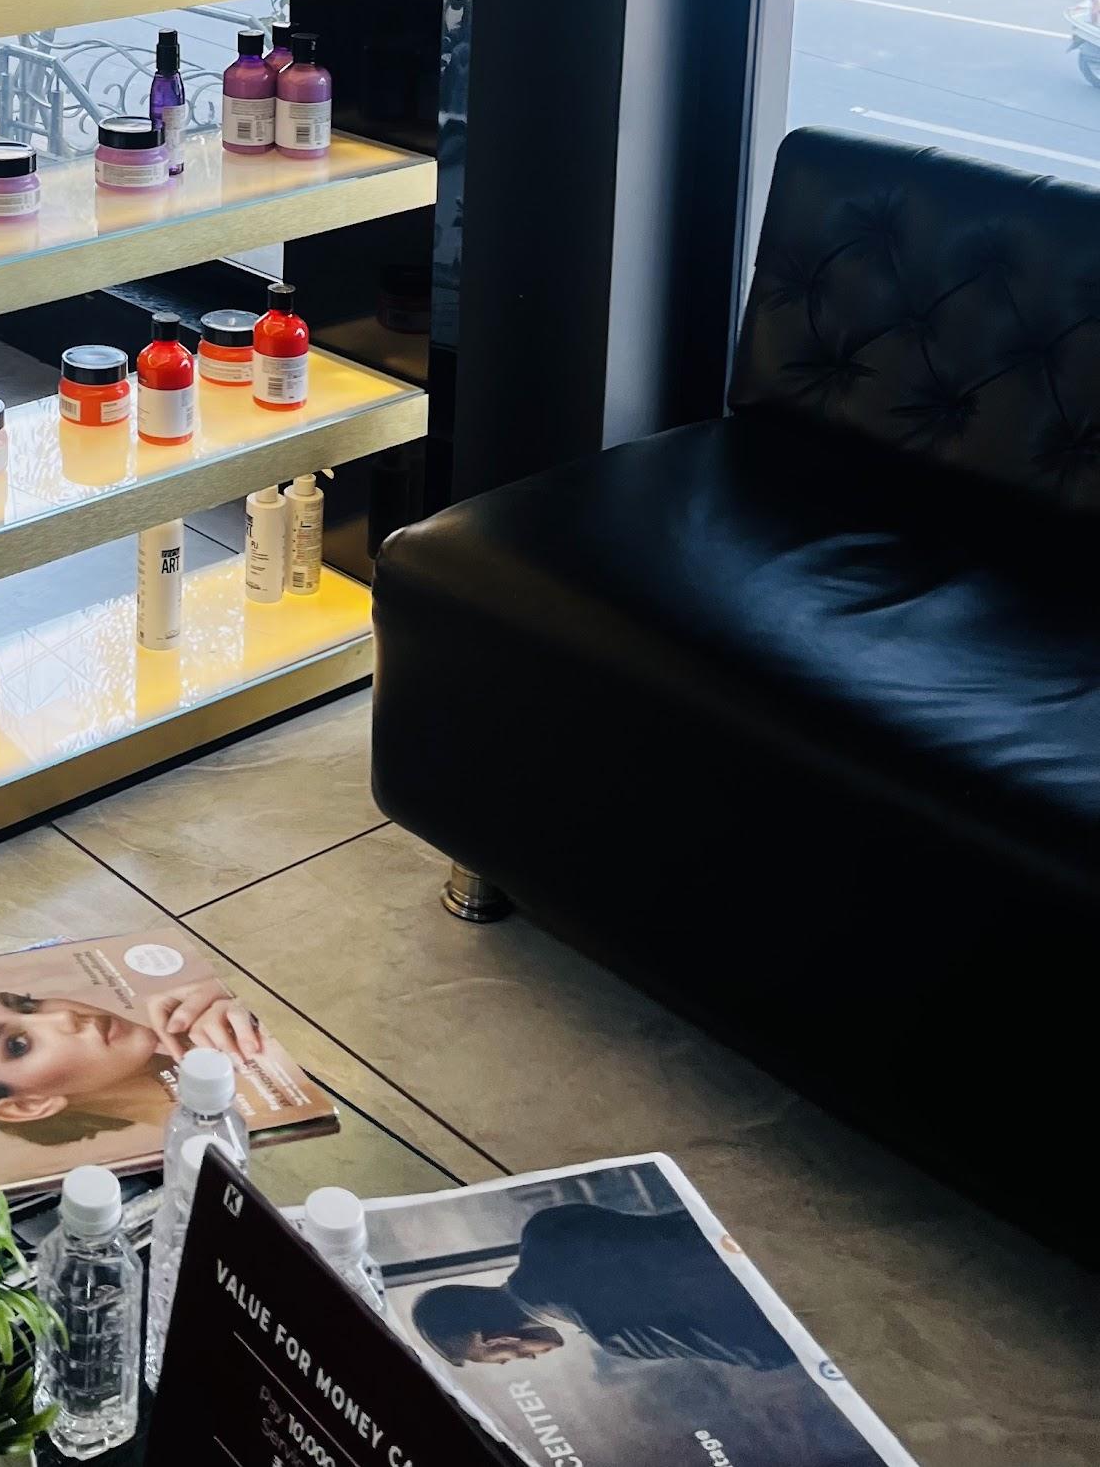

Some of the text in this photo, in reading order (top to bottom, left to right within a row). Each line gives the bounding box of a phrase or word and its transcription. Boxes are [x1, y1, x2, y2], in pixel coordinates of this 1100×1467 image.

[161, 555, 180, 574] ART
[216, 1259, 272, 1332] VALUE
[275, 1324, 312, 1377] FOR
[315, 1367, 384, 1449] MONEY
